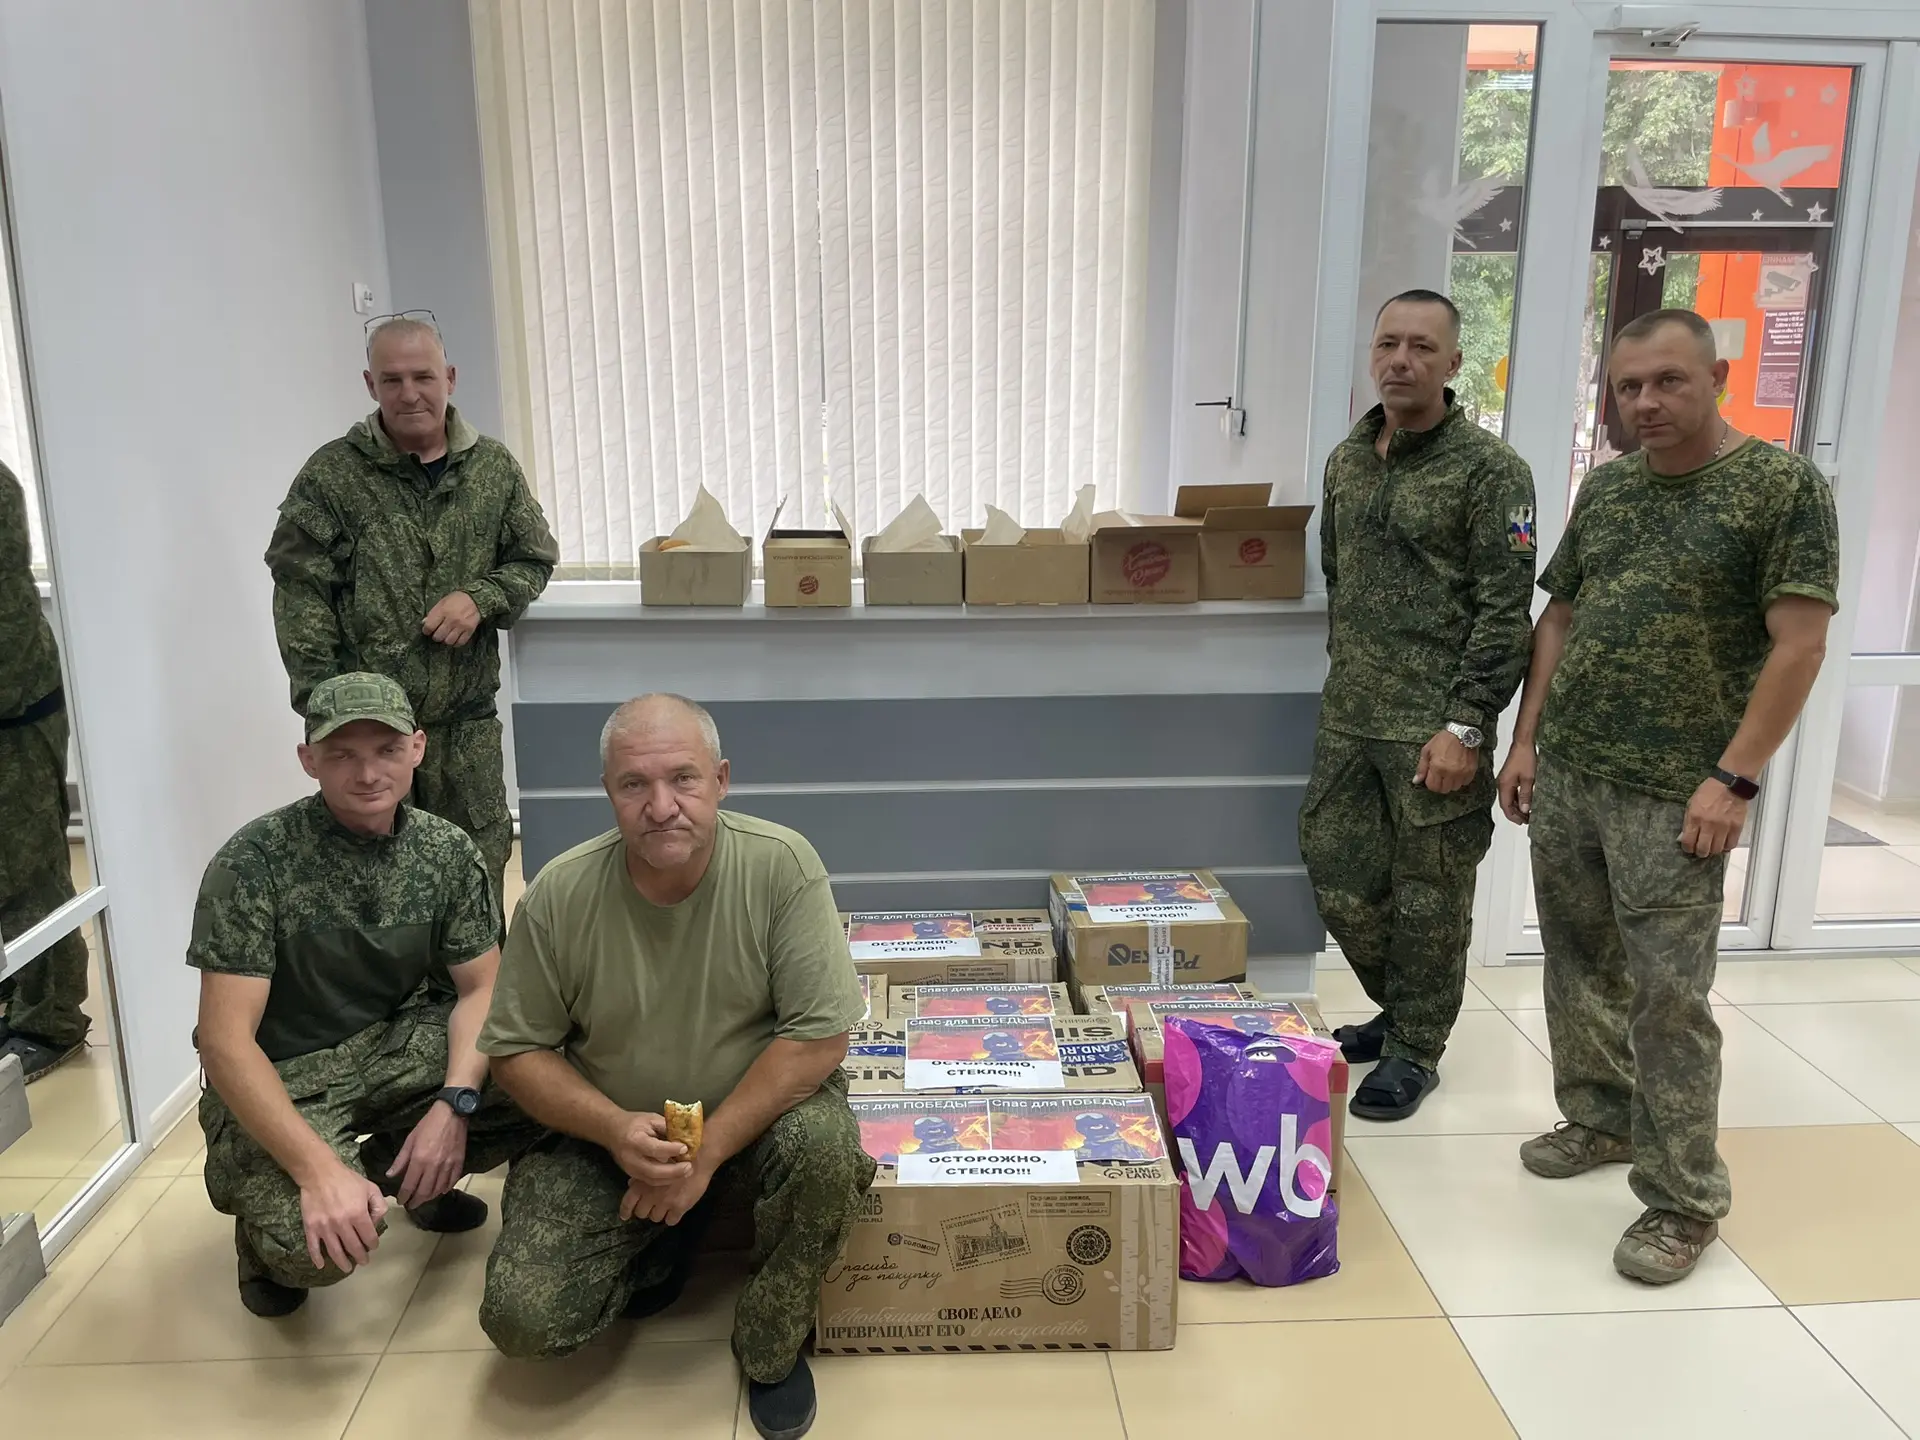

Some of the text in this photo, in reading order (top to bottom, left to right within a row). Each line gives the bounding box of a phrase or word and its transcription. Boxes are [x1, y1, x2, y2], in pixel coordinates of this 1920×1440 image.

[1110, 905, 1198, 913] ОСТОРОЖНО,
[905, 912, 953, 920] ПОБЕДЫ
[871, 939, 958, 947] ОСТОРОЖНО,
[951, 986, 974, 994] для
[1138, 985, 1160, 993] для
[1188, 1002, 1212, 1010] для
[1213, 1001, 1273, 1010] ПОБЕДЫ
[944, 1018, 969, 1027] для
[971, 1017, 1028, 1025] ПОБЕДЫ
[931, 1060, 1036, 1069] ОСТОРОЖНО,
[946, 1068, 1022, 1078] СТЕКЛО!!!
[872, 1102, 899, 1111] для
[903, 1101, 968, 1109] ПОБЕДЫ
[992, 1098, 1126, 1109] Спас для ПОБЕДЫ
[928, 1153, 1047, 1165] ОСТОРОЖНО,
[1177, 1114, 1331, 1218] wb
[945, 1166, 1031, 1177] СТЕКЛО!!!
[997, 1208, 1017, 1220] 1723
[903, 1239, 936, 1251] СОЛОМОН
[999, 1246, 1026, 1257] РОССИЯ
[955, 1258, 979, 1268] RUSSIA
[823, 1255, 899, 1284] Спасибо
[845, 1271, 943, 1292] за покупку
[937, 1307, 979, 1320] СВОЕ
[980, 1306, 1022, 1321] ДЕЛО
[825, 1324, 933, 1339] ПРЕВРАЩАЕТ
[936, 1324, 966, 1337] ЕГО
[988, 1318, 1089, 1343] искусство
